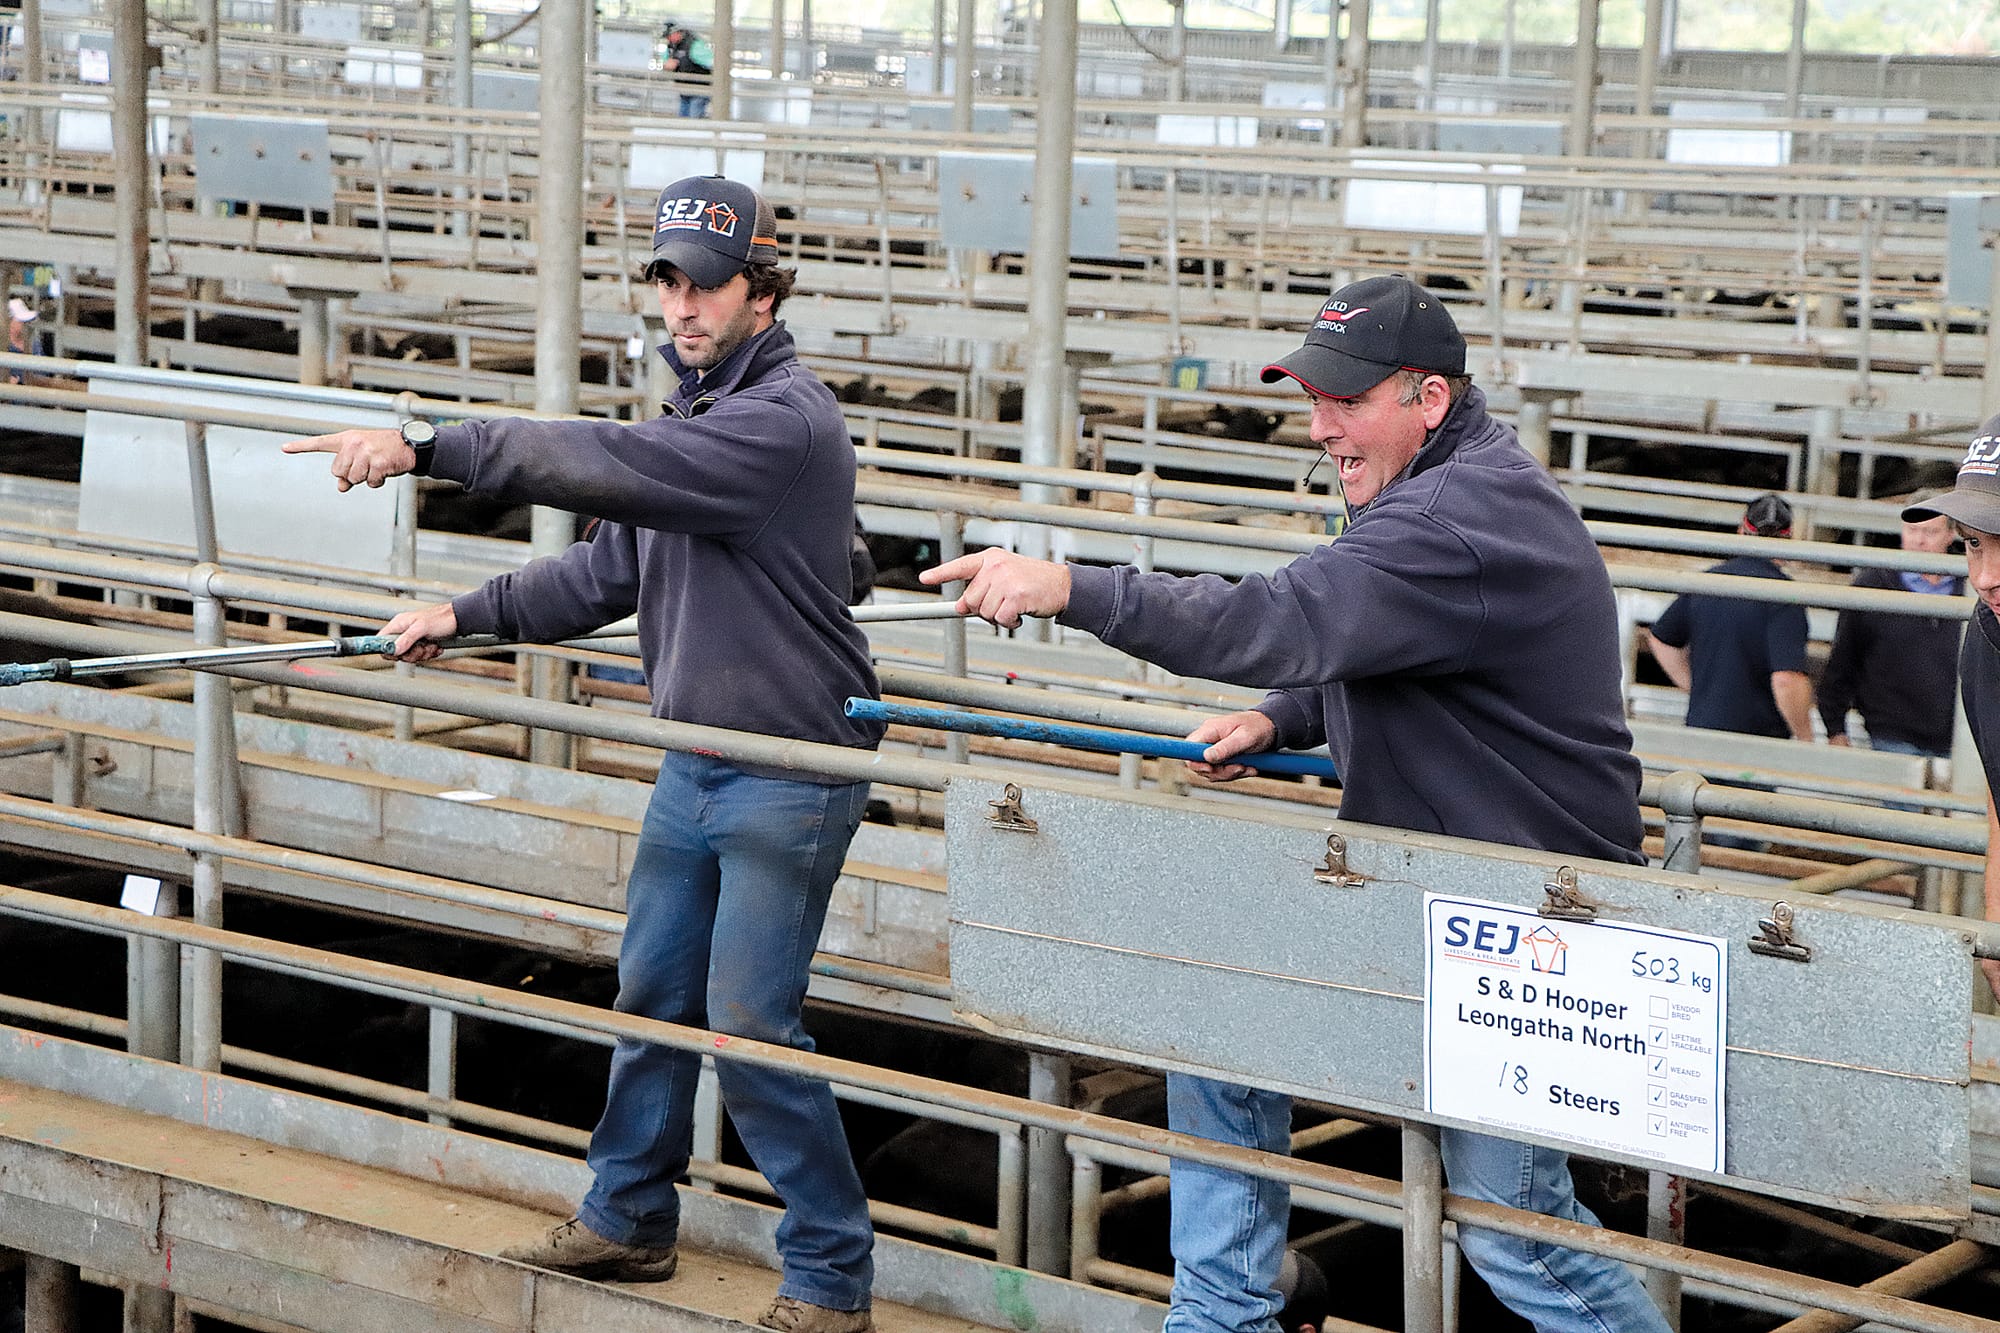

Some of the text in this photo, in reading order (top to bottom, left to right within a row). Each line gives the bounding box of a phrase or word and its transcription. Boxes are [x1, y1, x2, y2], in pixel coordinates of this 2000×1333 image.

[659, 198, 708, 223] SEJ
[1444, 916, 1521, 955] SEJ
[1444, 947, 1474, 956] LIVESTOCK
[1499, 956, 1521, 965] ESTATE
[1631, 951, 1711, 993] 503 kg
[1477, 976, 1628, 1020] S & D Hooper
[1671, 1002, 1701, 1015] VENDOR
[1671, 1011, 1691, 1021] BRED
[1458, 1003, 1646, 1056] Leongatha North
[1671, 1033, 1703, 1045] LIFETIME
[1671, 1040, 1713, 1055] TRACEABLE
[1670, 1066, 1702, 1078] WEANED
[1499, 1061, 1621, 1116] 18 Steers
[1669, 1091, 1708, 1105] GRASSFED
[1669, 1099, 1688, 1108] ONLY
[1669, 1128, 1688, 1138] FREE
[1670, 1120, 1709, 1135] ANTIBIOTIC
[1478, 1115, 1667, 1160] PARTICULARS FOR INFORMATION ONLY BUT NOT GUARANTEED
